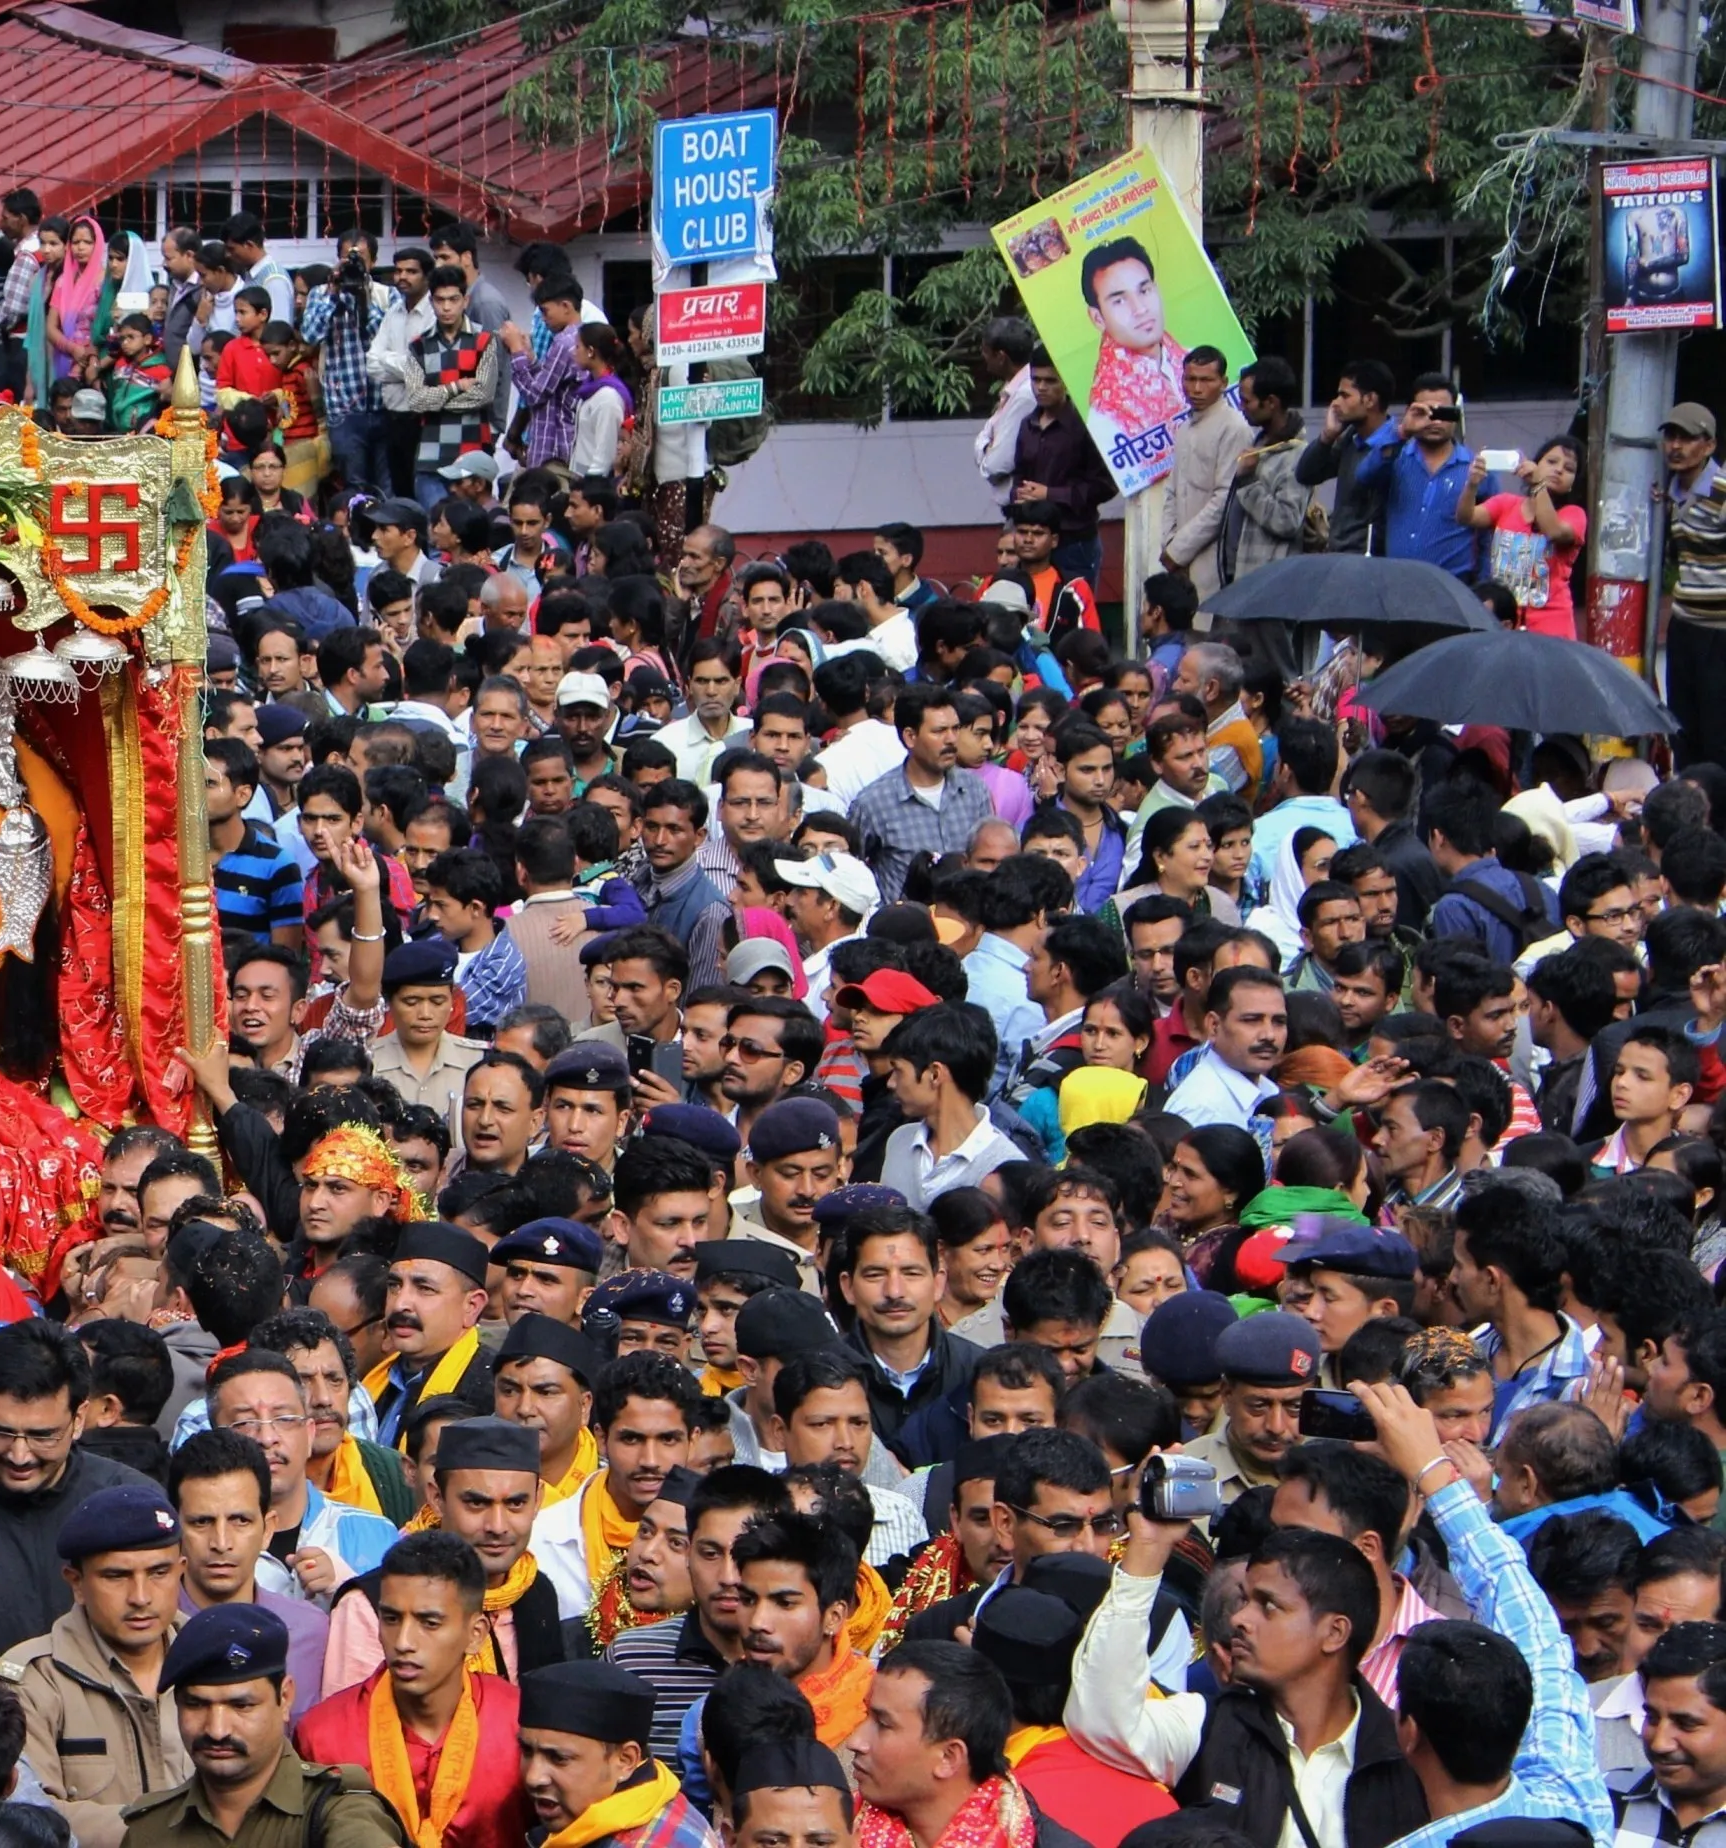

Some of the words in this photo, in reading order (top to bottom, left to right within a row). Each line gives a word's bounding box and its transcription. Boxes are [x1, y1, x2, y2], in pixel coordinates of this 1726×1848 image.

[682, 125, 751, 164] BOAT
[674, 167, 758, 208] HOUSE
[1611, 190, 1703, 208] TATTOO'S
[682, 212, 747, 250] CLUB
[682, 291, 742, 322] प्रचार
[662, 391, 685, 404] LAKE
[1108, 423, 1174, 469] नीरज
